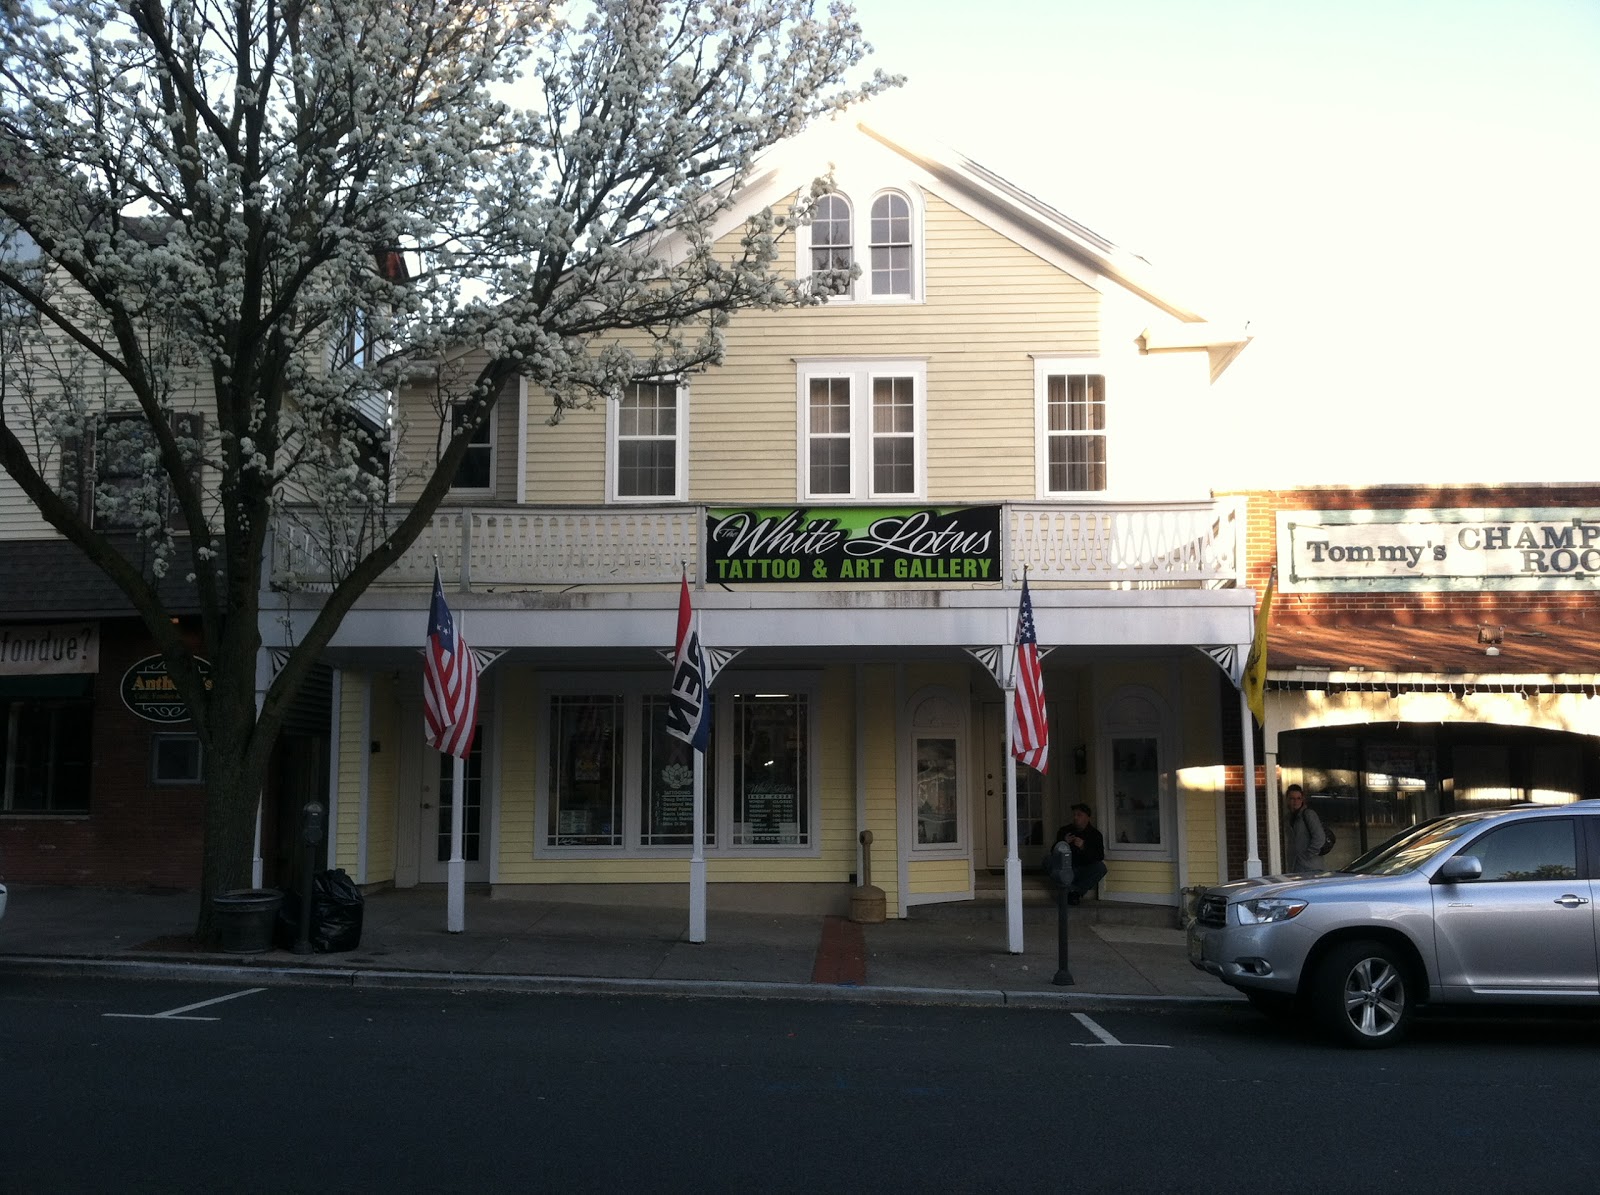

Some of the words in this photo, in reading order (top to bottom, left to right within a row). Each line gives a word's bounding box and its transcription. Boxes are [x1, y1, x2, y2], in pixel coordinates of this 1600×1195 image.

[713, 508, 840, 557] White
[719, 528, 739, 538] The
[844, 512, 992, 557] Lotus
[1458, 526, 1600, 551] CHAMP
[1306, 540, 1447, 568] Tommy's
[715, 558, 801, 579] TATTOO
[812, 558, 828, 579] &
[840, 558, 884, 579] ART
[895, 558, 992, 579] GALLERY
[0, 627, 92, 662] fondue?
